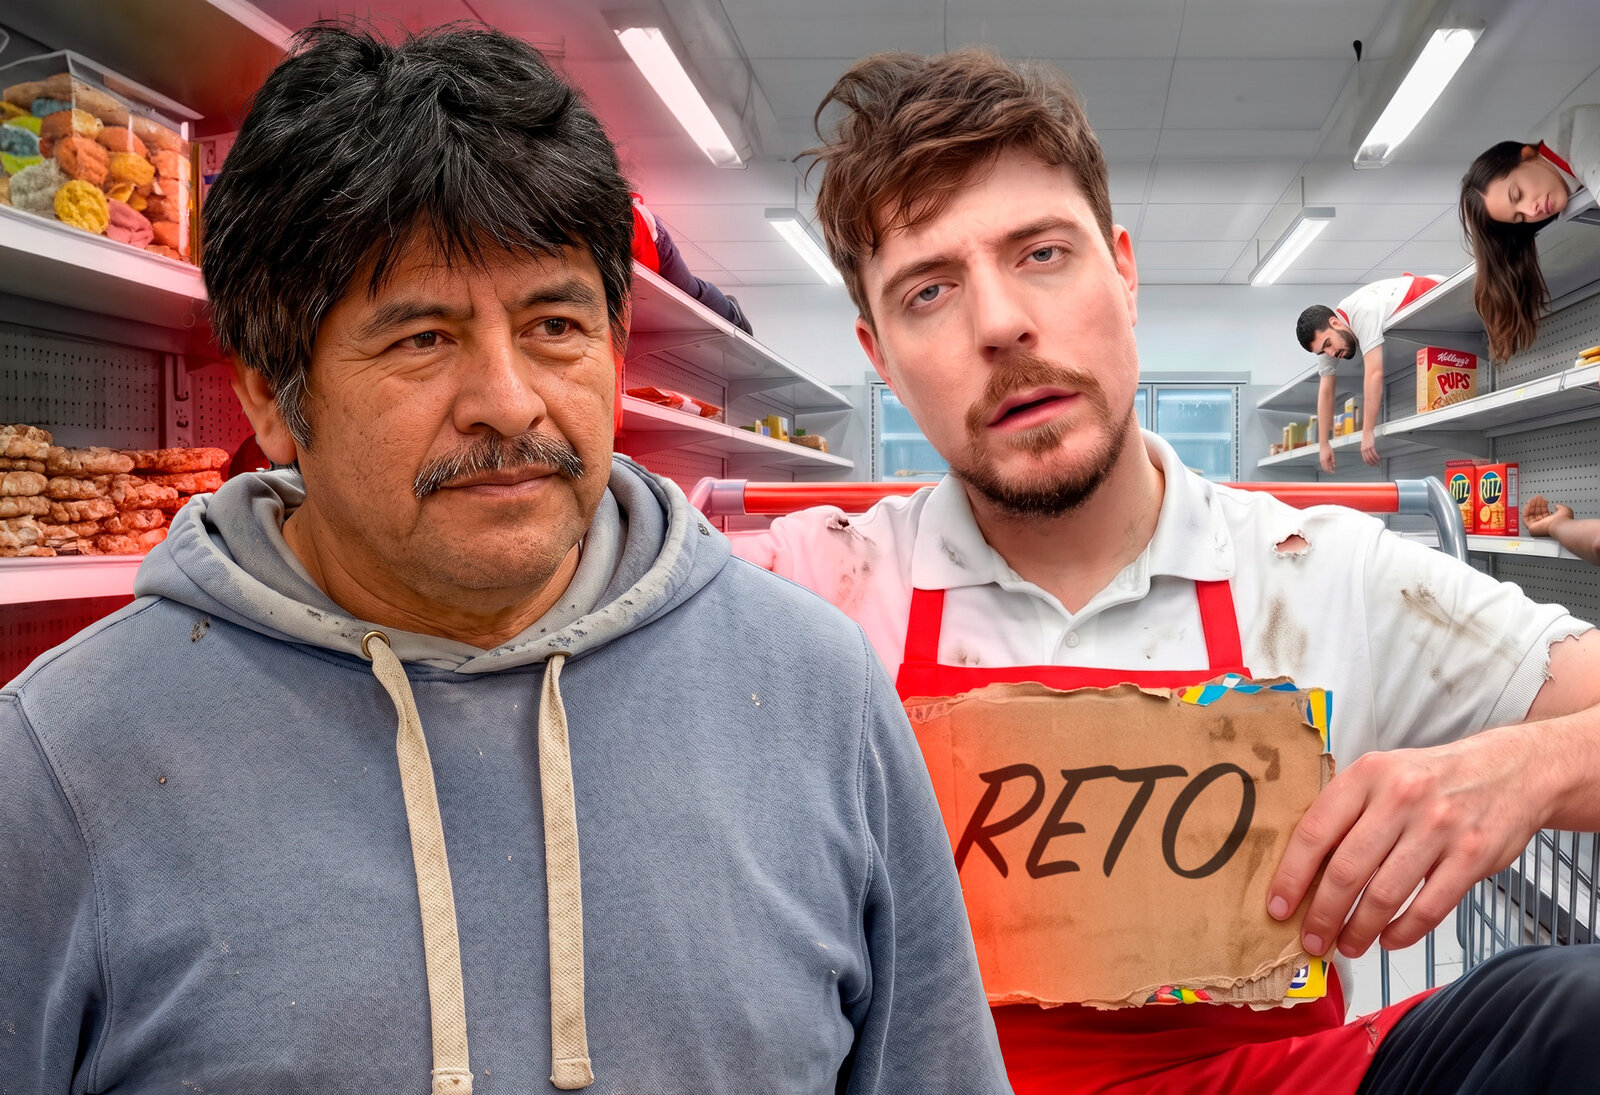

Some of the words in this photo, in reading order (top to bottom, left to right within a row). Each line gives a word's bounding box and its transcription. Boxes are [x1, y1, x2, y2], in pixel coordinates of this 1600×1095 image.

[1436, 371, 1471, 395] PUPS
[1450, 479, 1470, 500] RITZ
[1480, 477, 1502, 499] RITZ
[954, 763, 1256, 879] RETO
